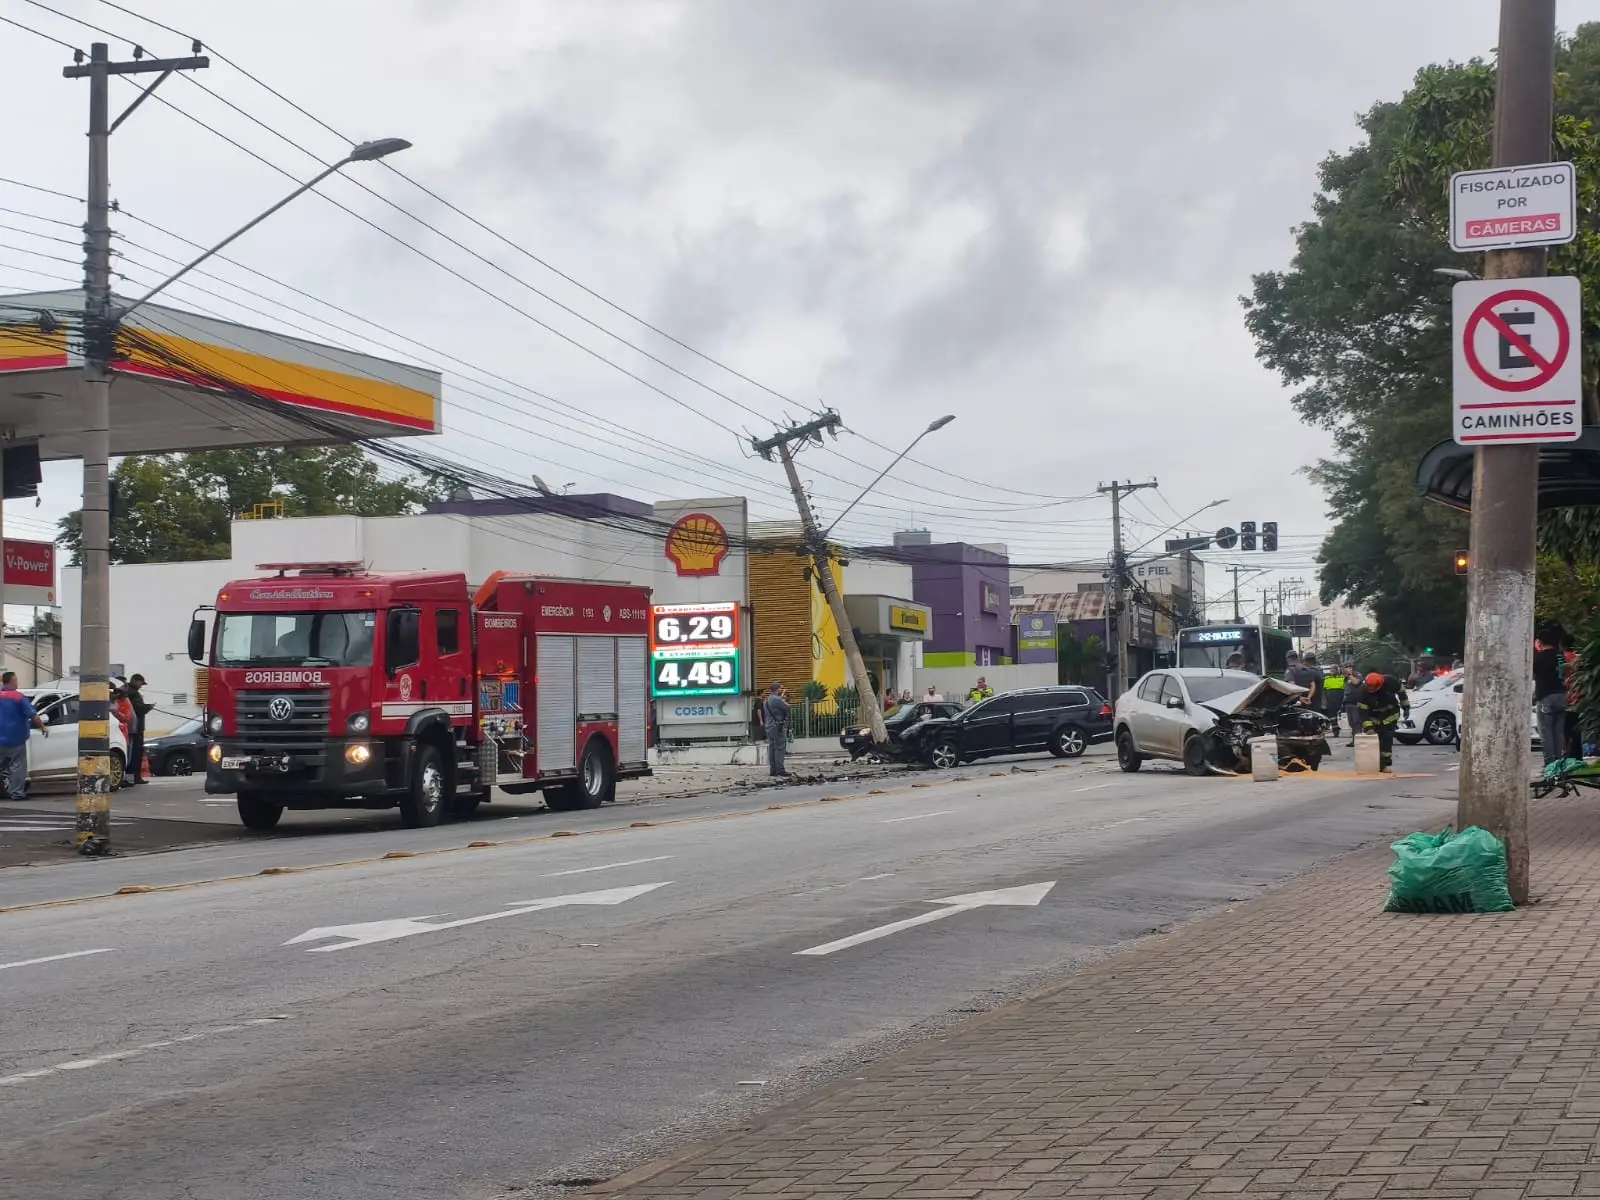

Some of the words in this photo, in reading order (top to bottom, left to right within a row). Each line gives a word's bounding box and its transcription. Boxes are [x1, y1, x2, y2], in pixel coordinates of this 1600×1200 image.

[1460, 173, 1566, 194] FISCALIZADO
[1497, 196, 1528, 210] POR
[1469, 216, 1557, 237] CÂMERAS
[1499, 311, 1536, 370] E
[1461, 411, 1574, 430] CAMINHÕES
[484, 617, 518, 629] BOMBEIROS
[658, 615, 732, 642] 6,29
[658, 660, 732, 688] 4,49
[675, 705, 714, 717] cosan
